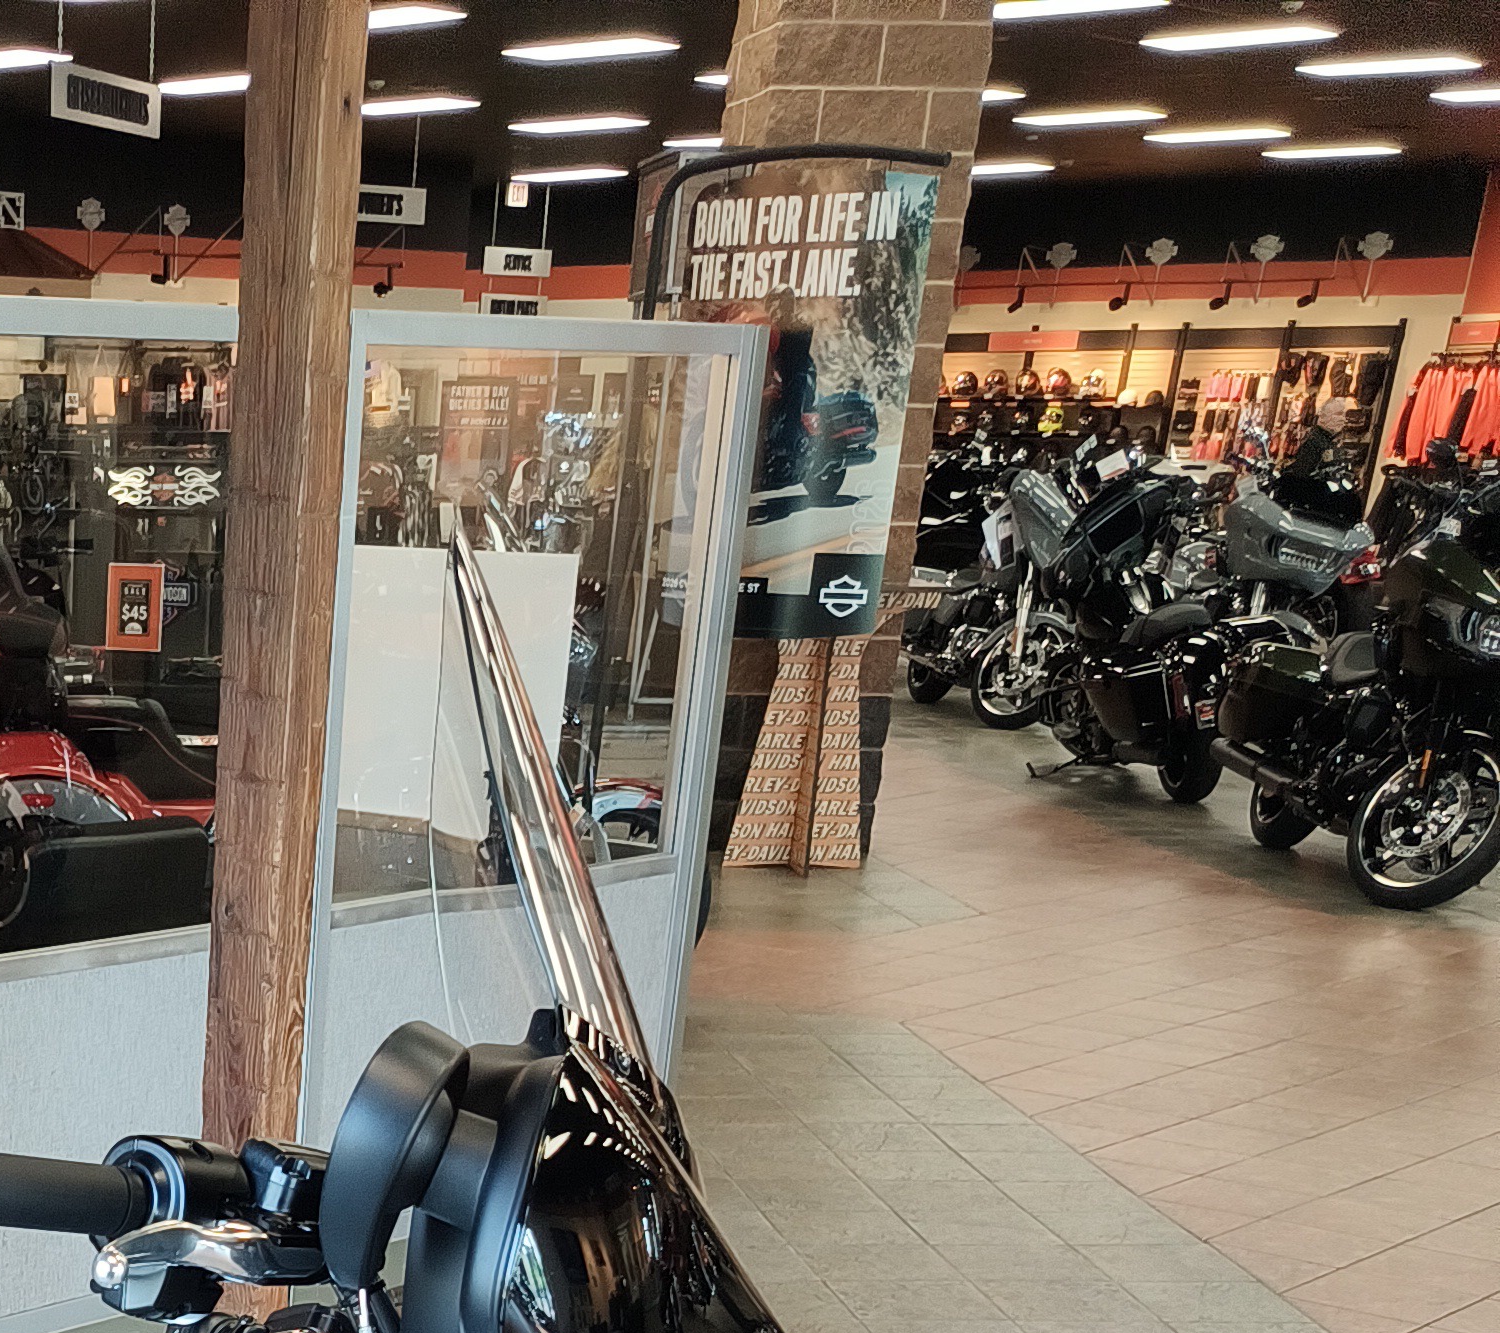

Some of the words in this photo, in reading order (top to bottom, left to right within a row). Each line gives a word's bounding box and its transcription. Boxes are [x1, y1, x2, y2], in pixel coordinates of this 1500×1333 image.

[693, 198, 753, 248] BORN
[755, 195, 803, 245] FOR
[805, 192, 864, 243] LIFE
[866, 191, 901, 240] IN
[690, 253, 728, 300] THE
[728, 250, 787, 299] FAST
[787, 248, 861, 298] LANE.
[492, 385, 509, 397] DAY
[121, 603, 147, 621] $45
